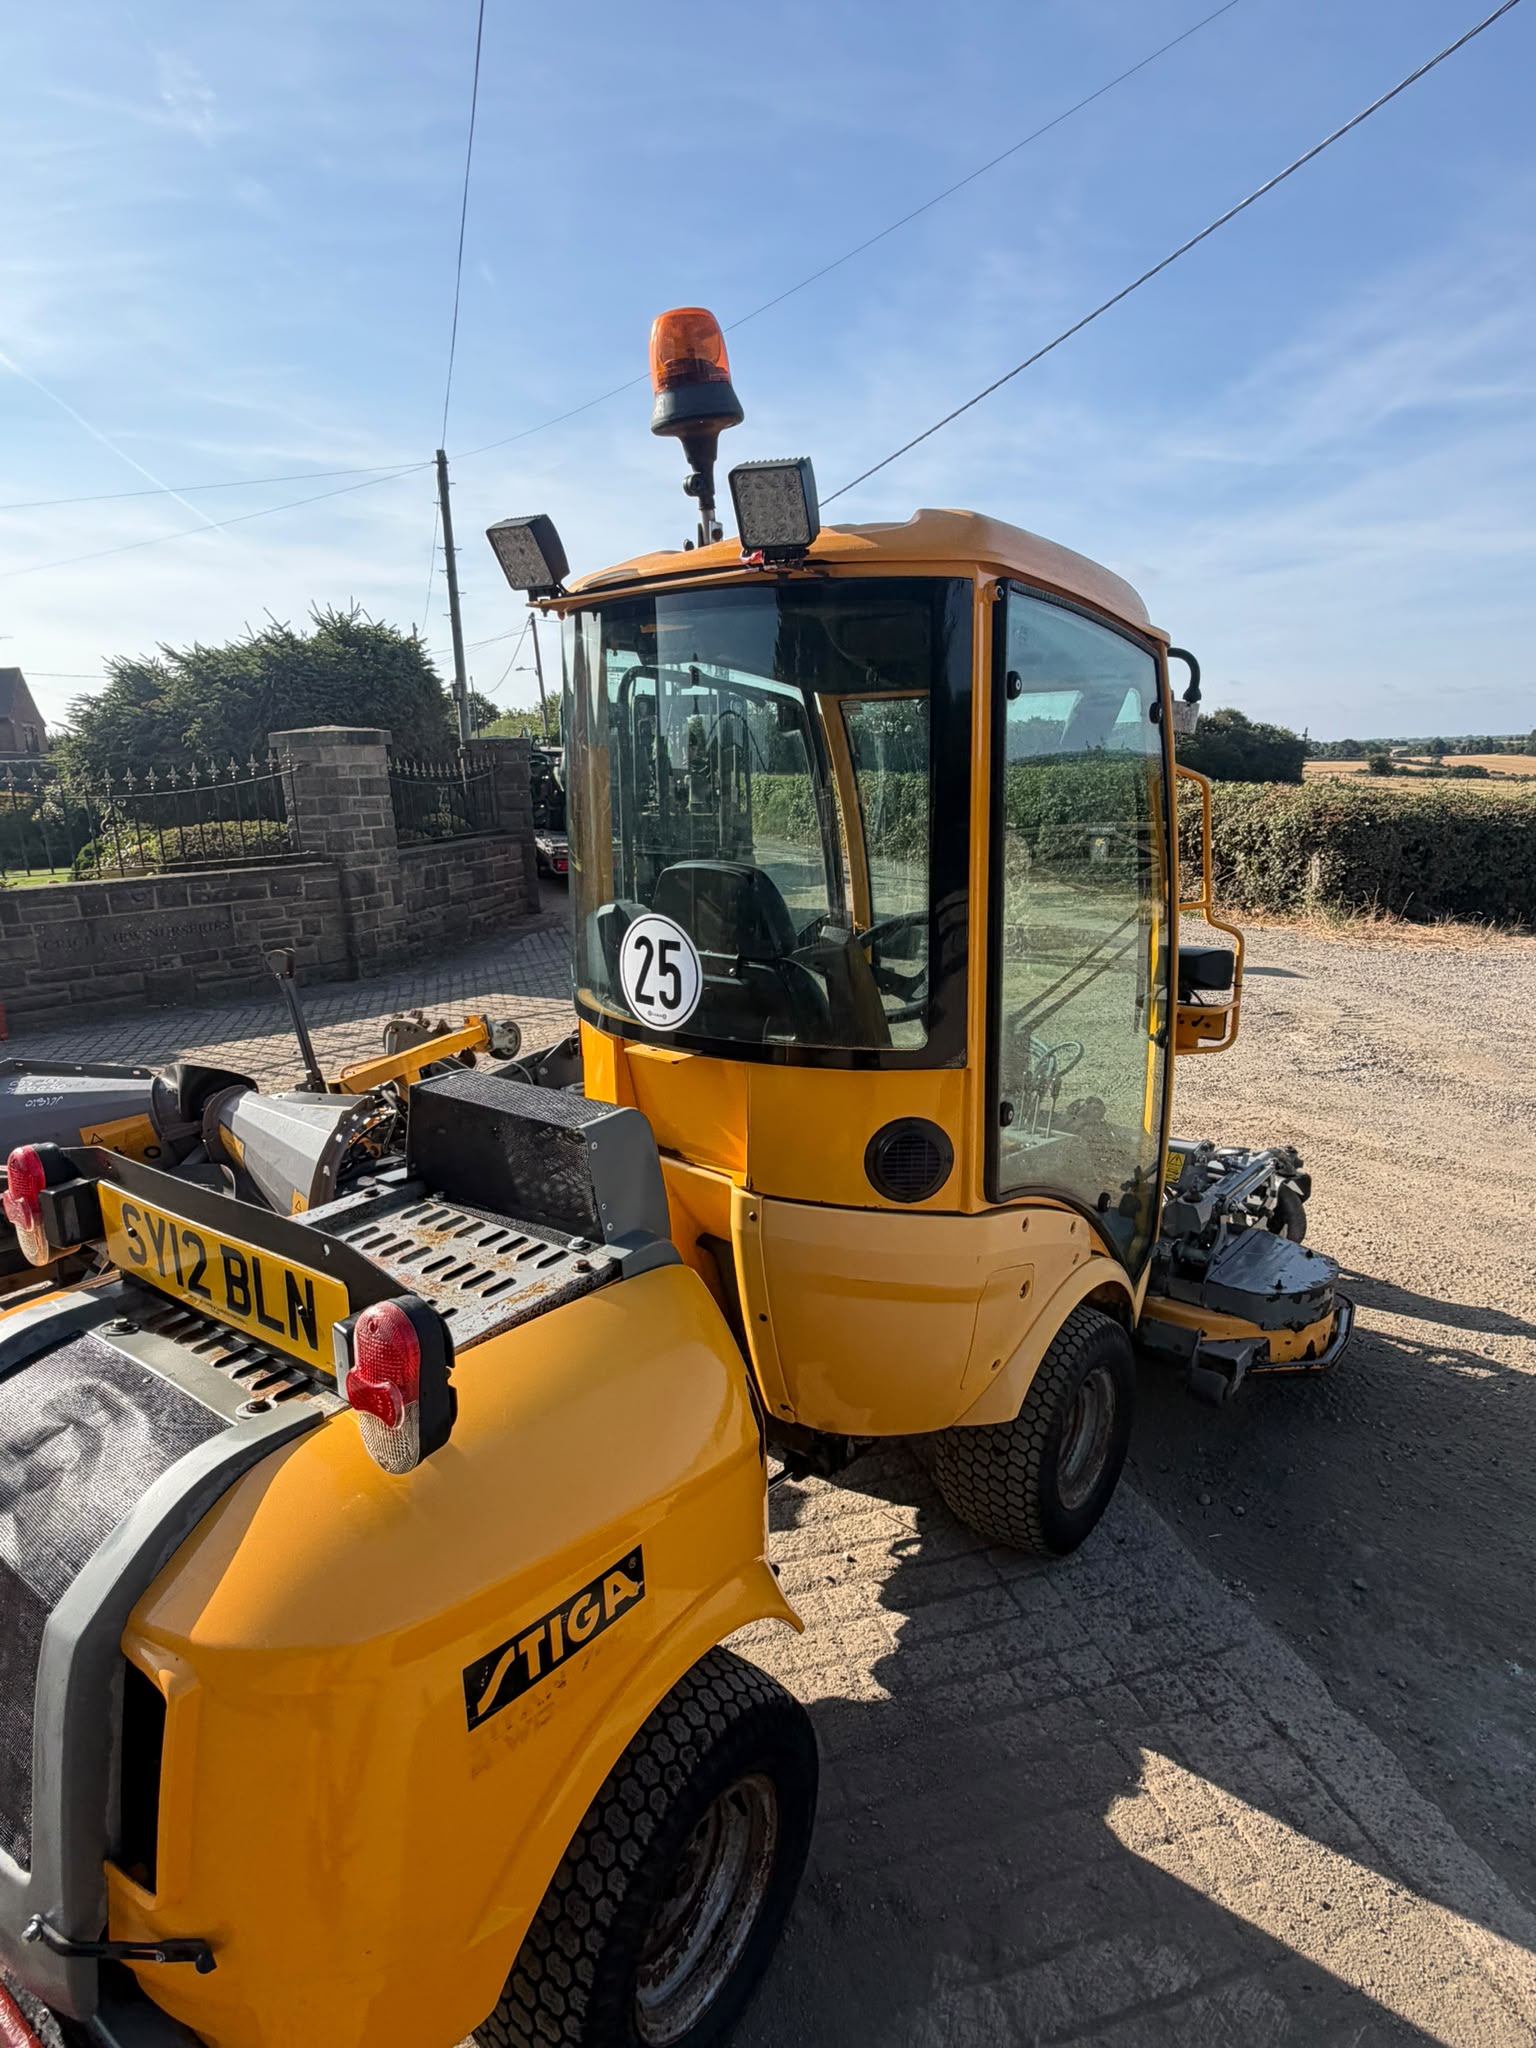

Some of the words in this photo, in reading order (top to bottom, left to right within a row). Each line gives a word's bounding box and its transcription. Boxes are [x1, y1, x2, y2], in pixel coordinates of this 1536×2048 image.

[103, 931, 142, 944] VIEW
[148, 920, 231, 938] NURSERIES
[634, 935, 682, 1010] 25
[122, 1203, 212, 1300] SY12
[220, 1244, 318, 1351] BLN
[476, 1571, 640, 1717] STIGA
